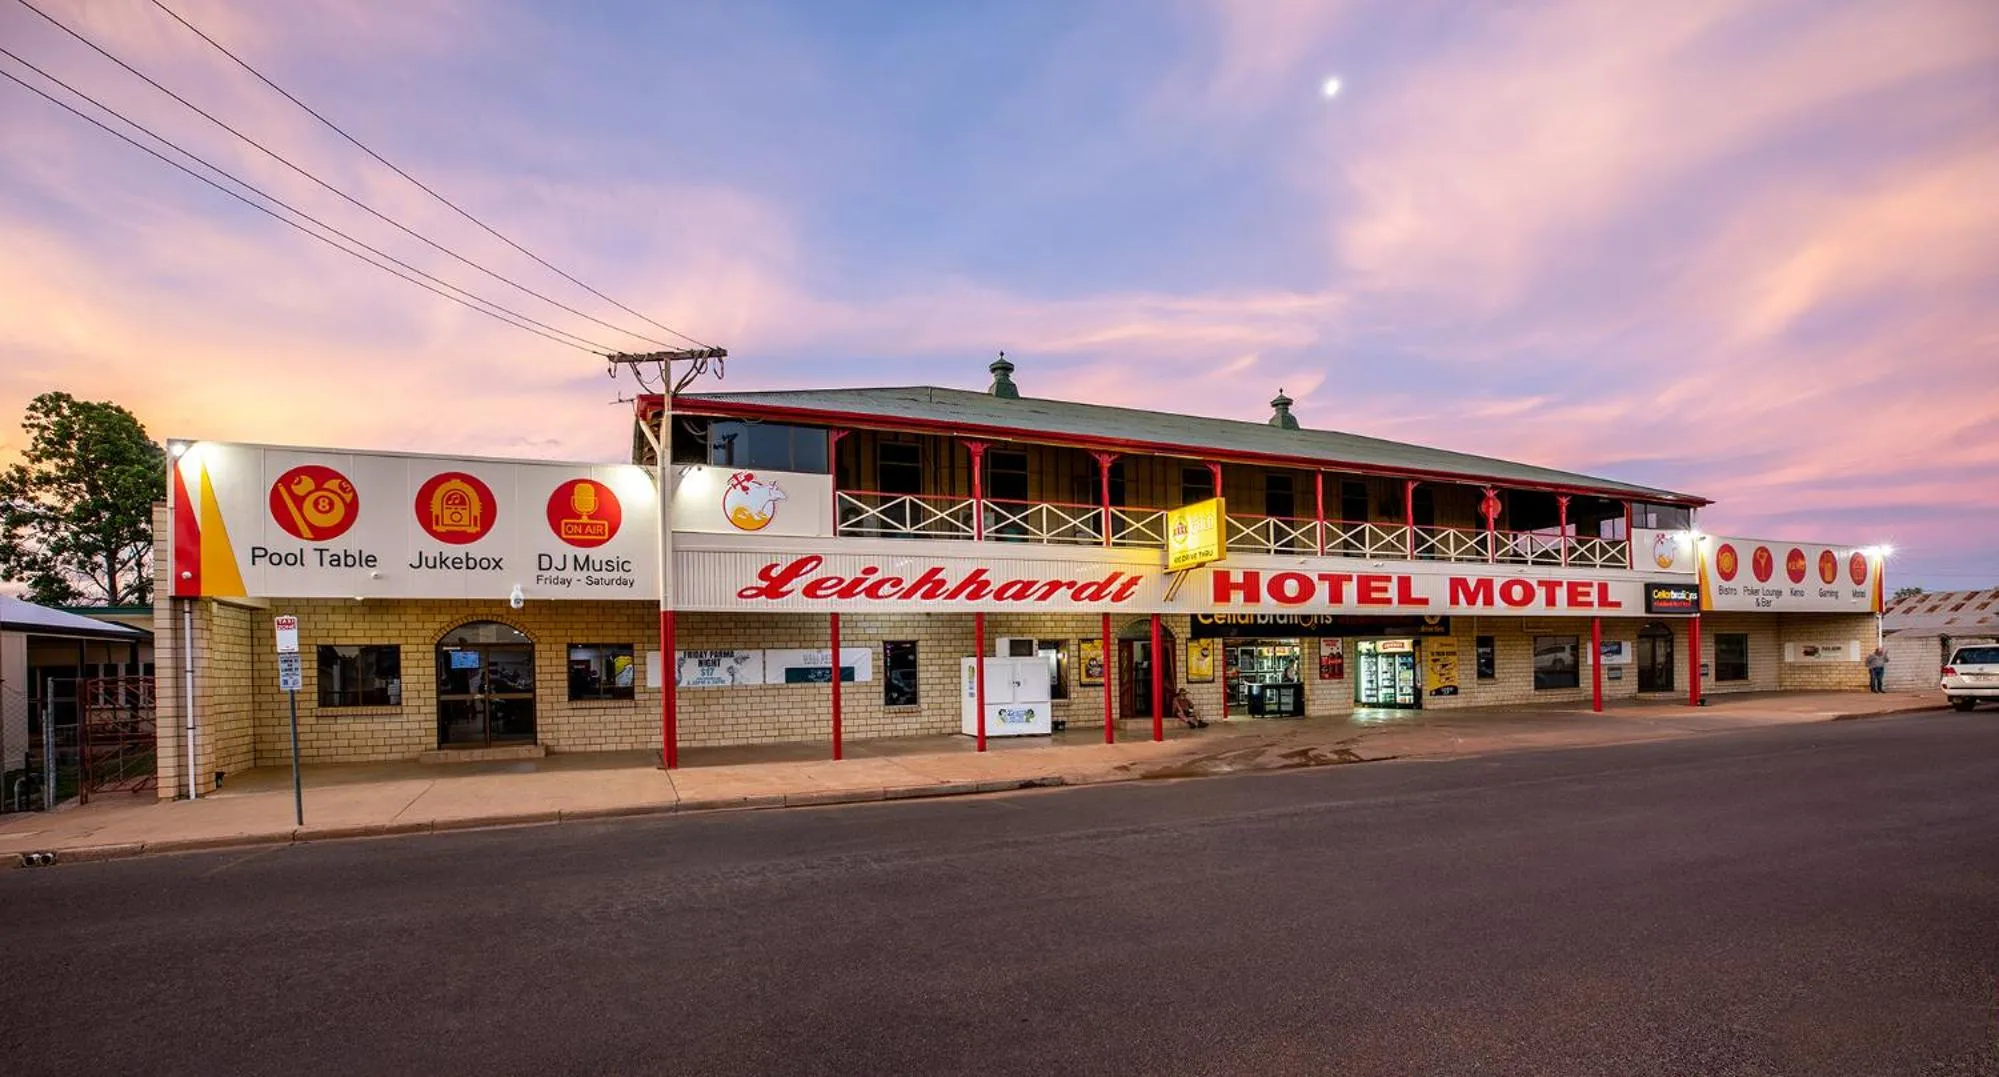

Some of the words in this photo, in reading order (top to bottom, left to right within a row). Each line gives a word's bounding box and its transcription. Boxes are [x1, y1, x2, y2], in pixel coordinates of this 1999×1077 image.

[317, 496, 330, 512] 8
[565, 524, 582, 534] ON
[584, 525, 604, 535] AIR
[251, 546, 305, 567] Pool
[313, 547, 378, 568] Table
[408, 550, 504, 571] Jukebox
[537, 553, 567, 572] DJ
[573, 554, 632, 573] Music
[536, 575, 572, 588] Friday
[585, 575, 635, 589] Saturday
[737, 555, 1143, 602] Leichhardt
[1213, 571, 1429, 606] HOTEL
[1450, 576, 1622, 608] MOTEL
[1718, 585, 1738, 596] Bistro
[1743, 586, 1760, 597] Poker
[1761, 587, 1783, 602] Lounge
[1790, 588, 1805, 598] Keno
[1818, 588, 1839, 600] Gaming
[1762, 598, 1773, 608] Bar
[683, 650, 708, 658] FRIDAY
[697, 658, 721, 668] NIGHT
